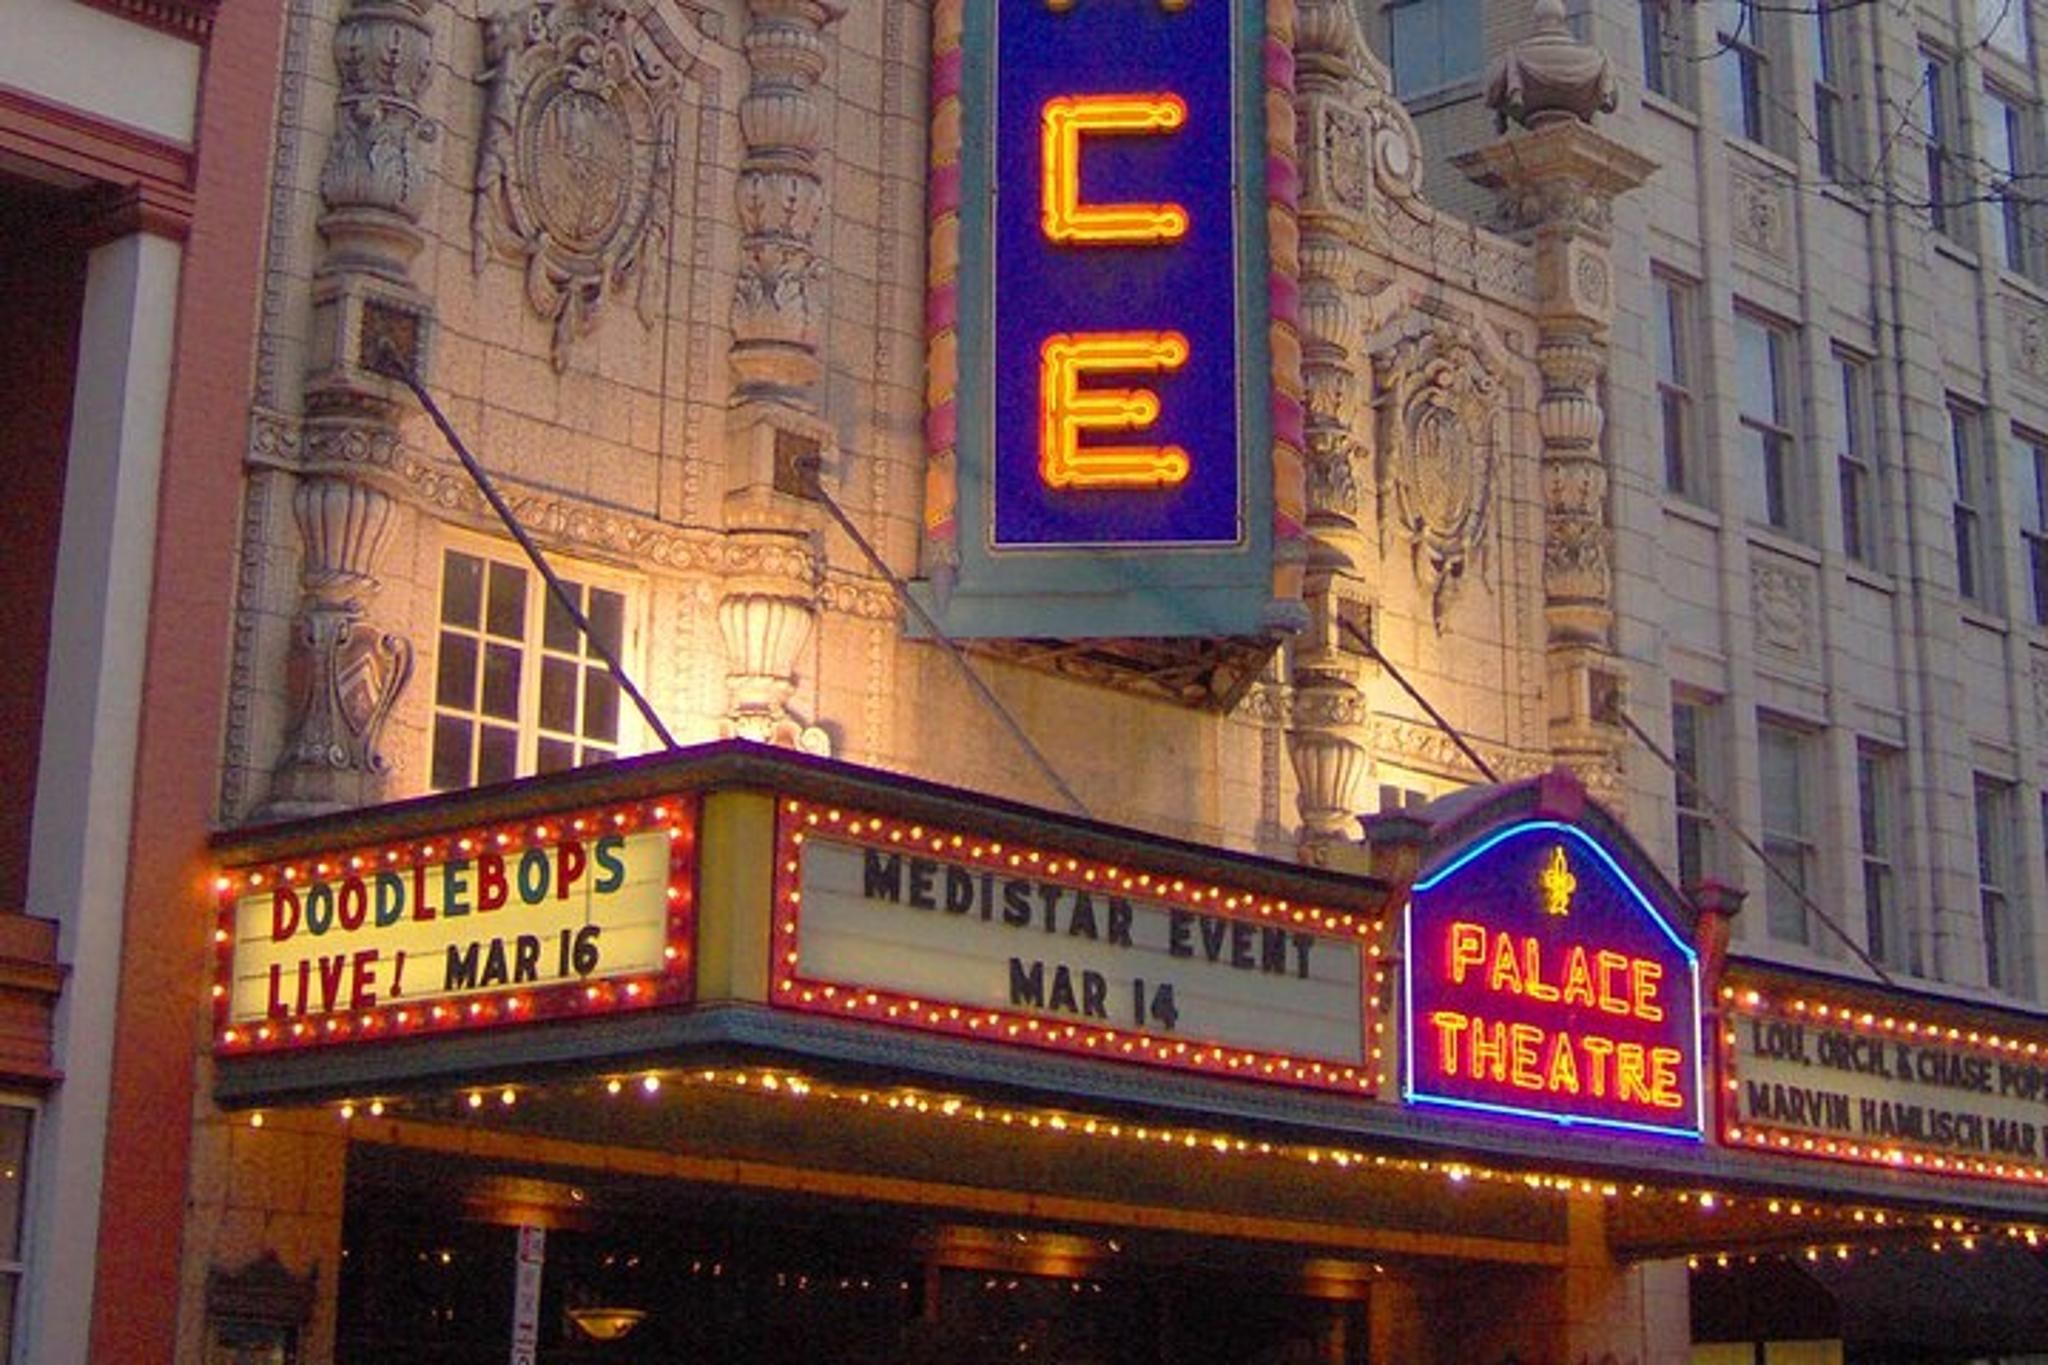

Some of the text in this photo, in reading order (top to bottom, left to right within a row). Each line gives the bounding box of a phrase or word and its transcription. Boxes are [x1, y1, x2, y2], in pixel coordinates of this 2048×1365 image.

[1040, 0, 1189, 488] CE
[271, 836, 625, 942] DOODLEBOPS
[863, 848, 1317, 979] MEDISTAR EVENT
[266, 925, 602, 1017] LIVE! MAR 16
[1008, 957, 1179, 1031] MAR 14
[1451, 921, 1663, 1022] PALACE
[1431, 1011, 1683, 1108] THEATRE
[1917, 1048, 1993, 1094] CHASE
[2000, 1063, 2048, 1102] POP
[1747, 1080, 1851, 1131] MARVIN
[1860, 1097, 1984, 1151] HAMLISCH
[1988, 1117, 2037, 1158] MAR
